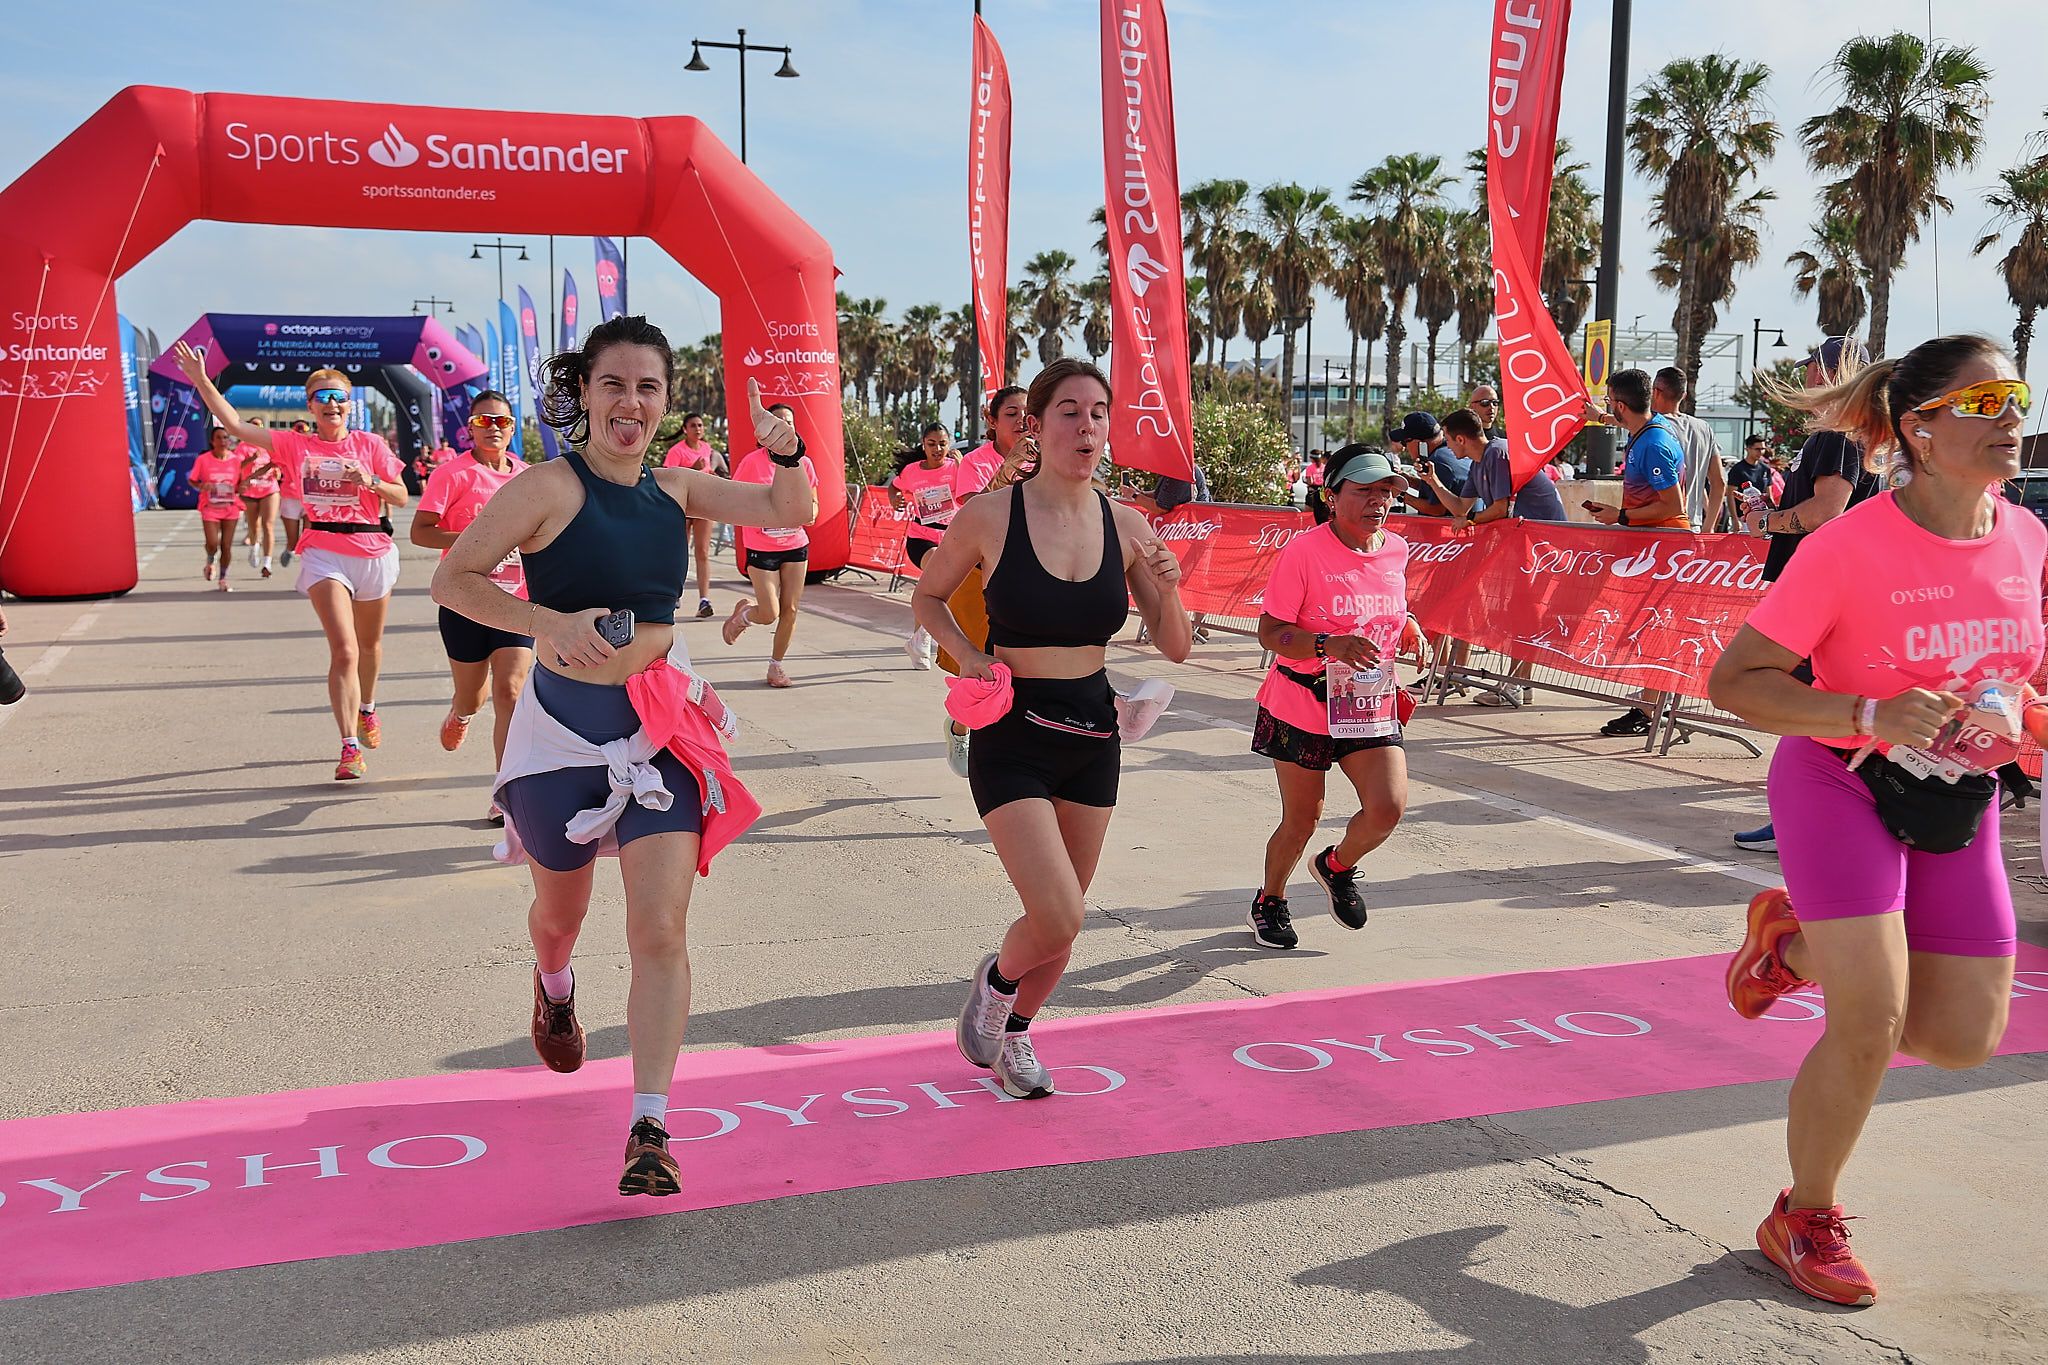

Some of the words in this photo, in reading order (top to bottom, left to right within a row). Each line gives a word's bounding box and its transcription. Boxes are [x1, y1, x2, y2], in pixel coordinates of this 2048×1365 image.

[225, 122, 360, 170] Sports
[427, 134, 629, 174] Santander
[362, 184, 496, 201] sportssantander.es
[12, 311, 79, 334] Sports
[767, 320, 819, 340] Sports
[9, 343, 108, 361] Santander
[314, 341, 340, 349] PARA
[341, 341, 379, 349] CORRER
[765, 348, 836, 364] Santander
[319, 479, 341, 488] 016
[1520, 541, 1616, 584] Sports
[1652, 549, 1770, 591] Santa
[1325, 573, 1359, 583] OYSHO
[1890, 585, 1954, 605] OYSHO
[1332, 595, 1401, 617] CARRERA
[1905, 618, 2035, 662] CARRERA
[1355, 696, 1382, 709] 016
[1337, 726, 1365, 734] OYSHO
[1232, 1010, 1652, 1073] OYSHO
[667, 1065, 1127, 1142] OYSHO
[0, 1134, 488, 1214] YSHO
